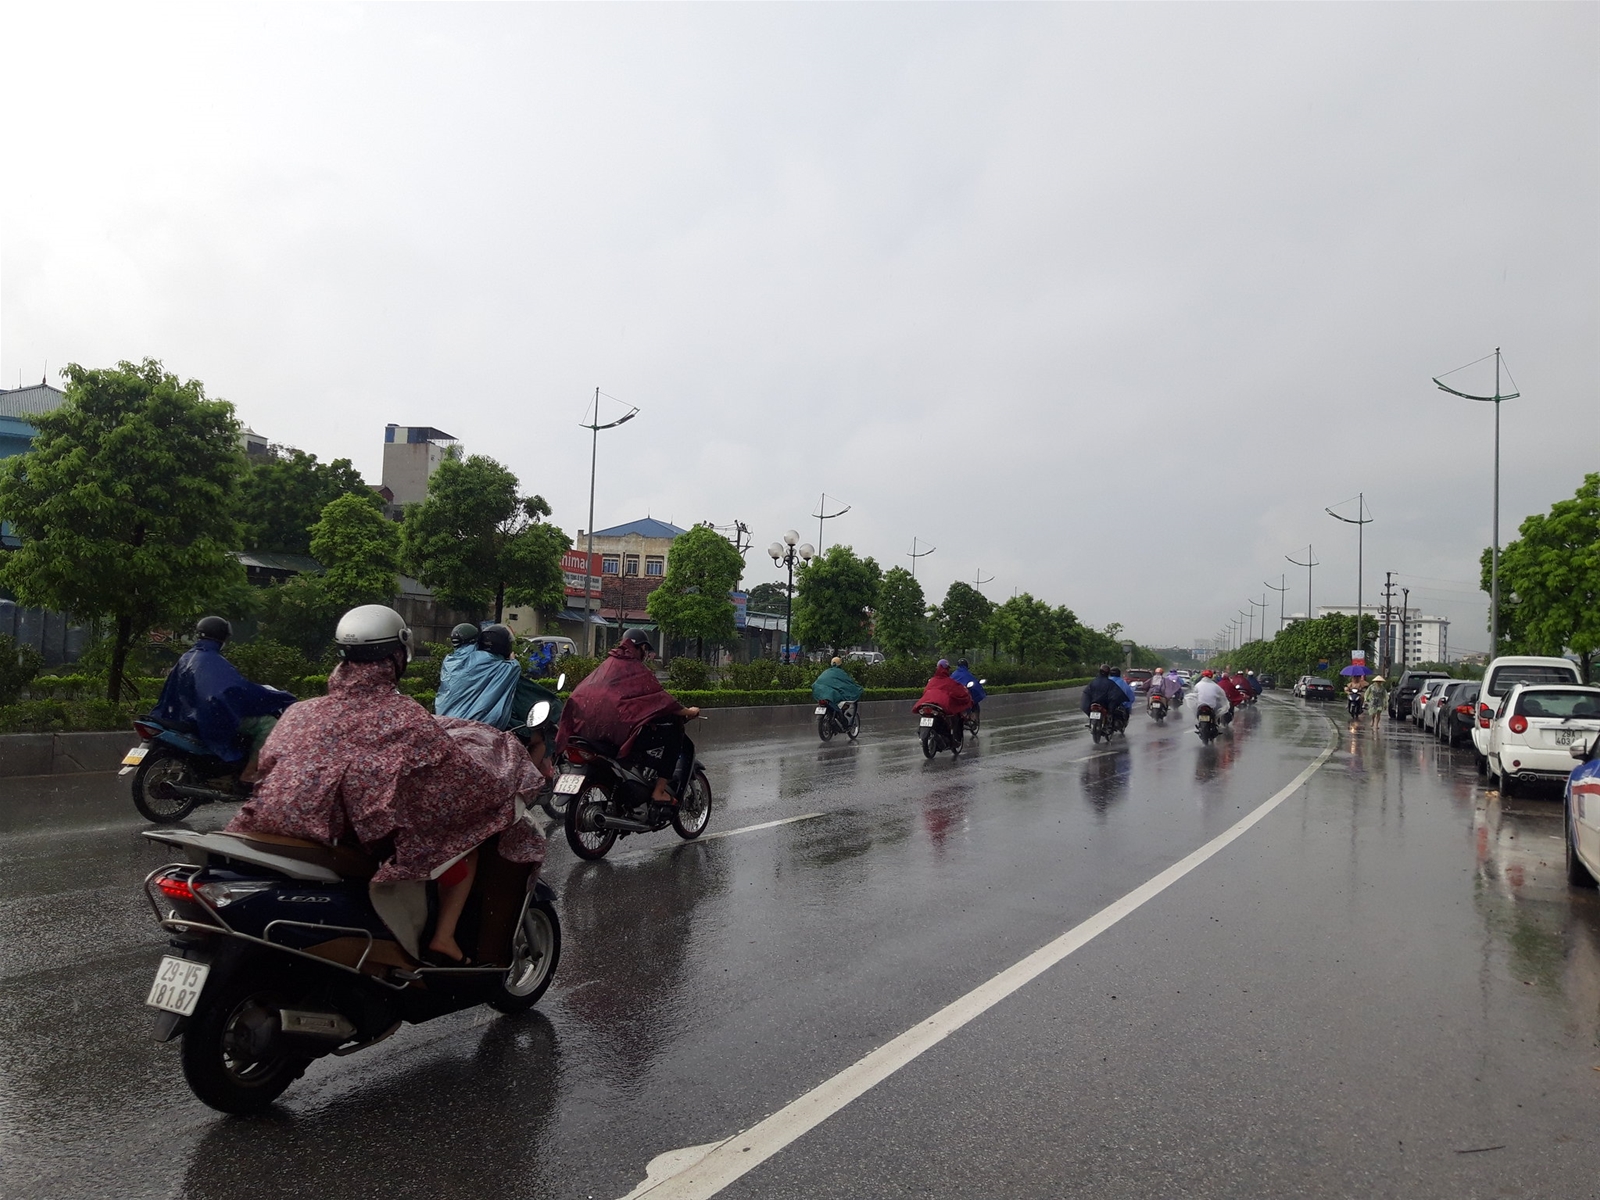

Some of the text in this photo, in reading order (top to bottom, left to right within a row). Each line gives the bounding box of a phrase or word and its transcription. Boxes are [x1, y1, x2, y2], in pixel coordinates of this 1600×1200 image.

[558, 783, 577, 793] 1452
[277, 895, 331, 903] LEAD
[160, 960, 202, 988] 29-V5
[150, 982, 197, 1012] 181.87
